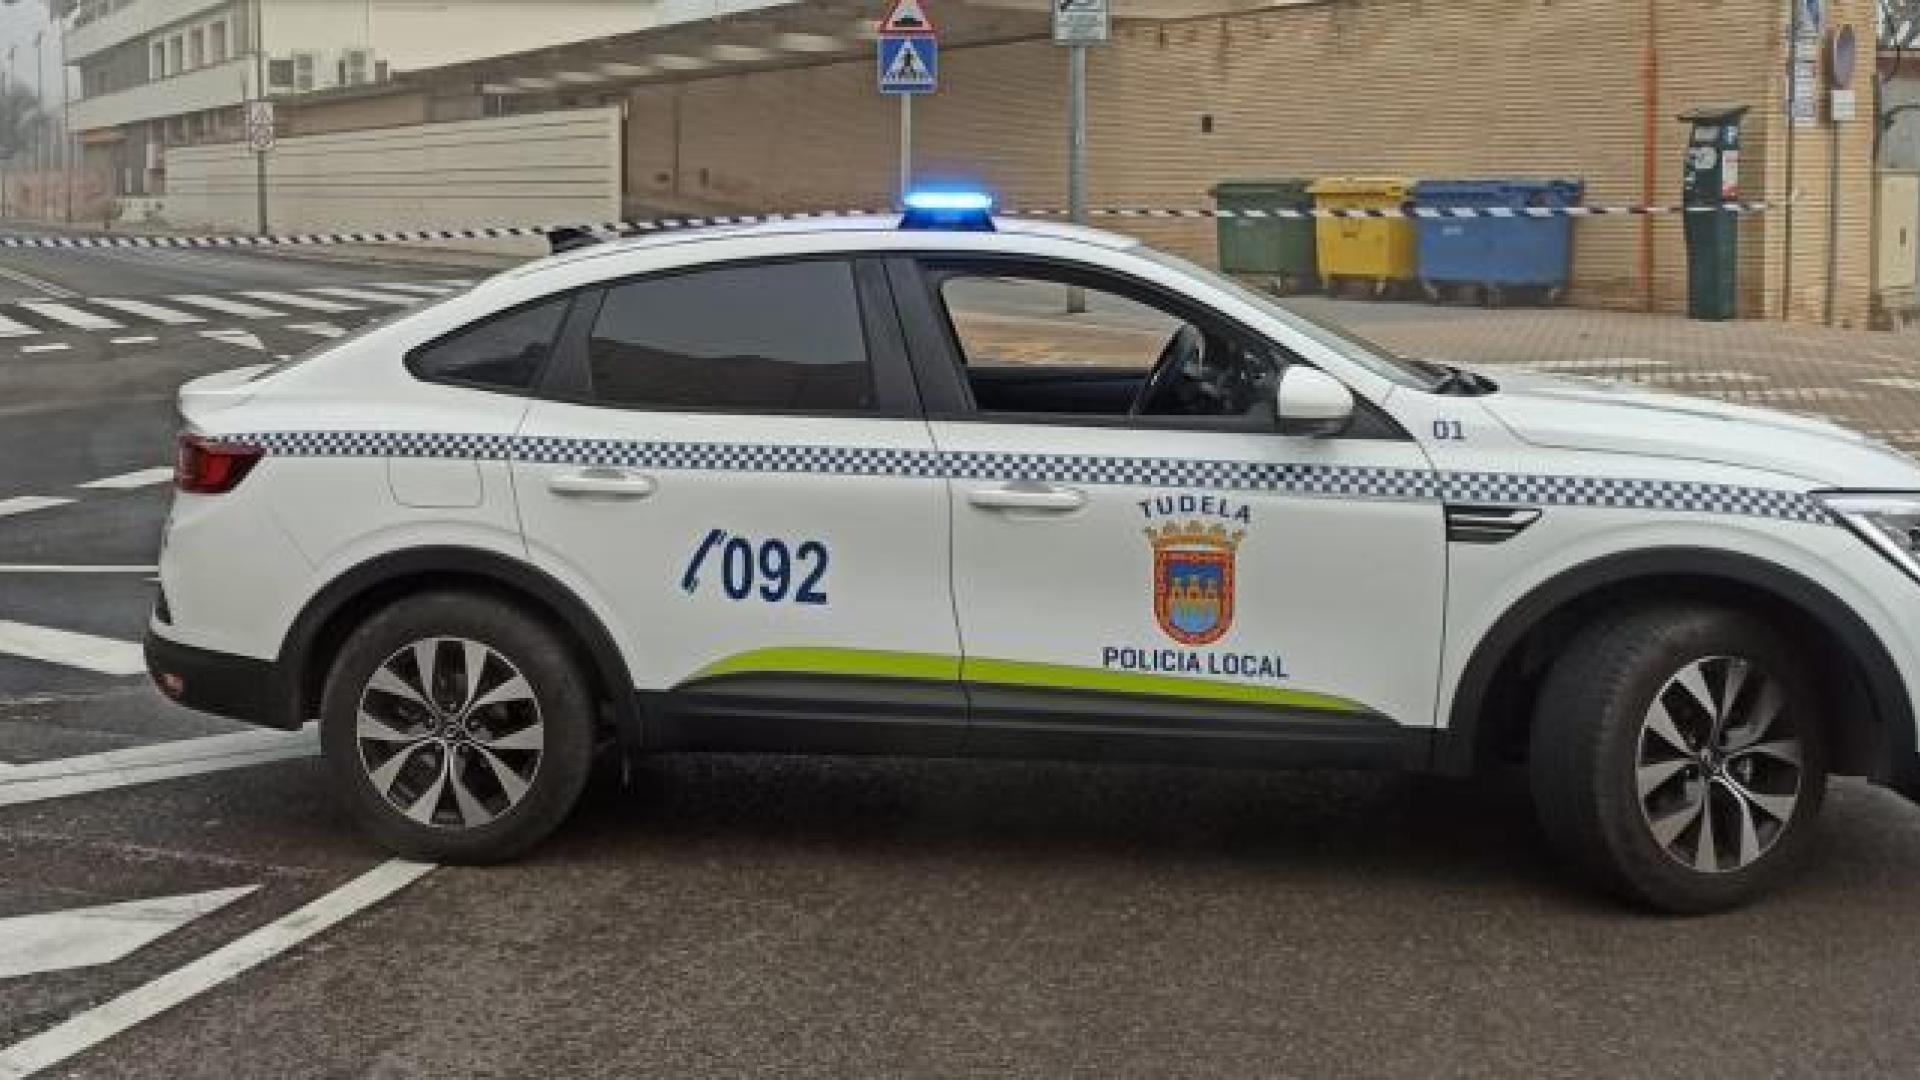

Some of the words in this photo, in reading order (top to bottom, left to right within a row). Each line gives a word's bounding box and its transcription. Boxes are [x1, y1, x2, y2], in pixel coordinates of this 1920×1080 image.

[1433, 420, 1464, 440] 01
[1137, 496, 1251, 523] TUDELA
[723, 537, 829, 604] 092
[1102, 646, 1200, 672] POLICIA
[1208, 653, 1289, 678] LOCAL
